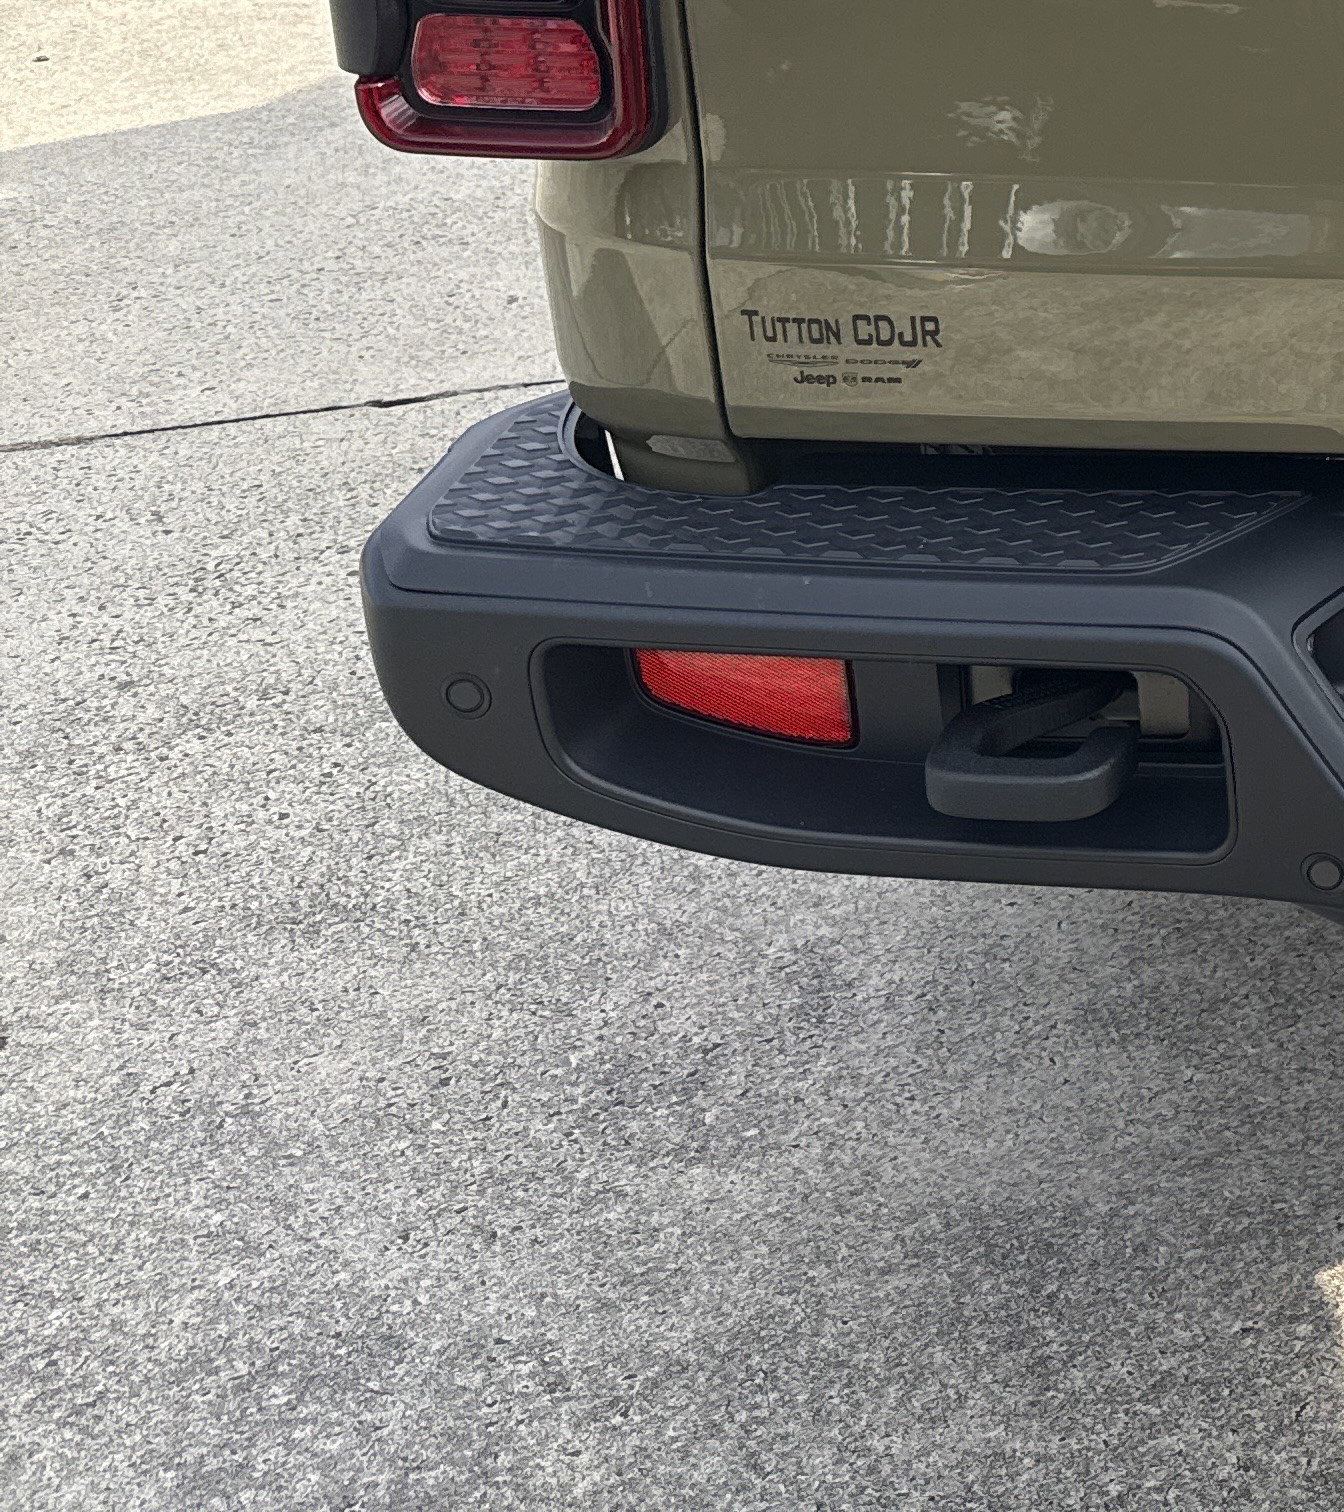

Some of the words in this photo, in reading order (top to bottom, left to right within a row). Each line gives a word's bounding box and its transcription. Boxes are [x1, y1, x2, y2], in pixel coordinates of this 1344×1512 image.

[740, 309, 842, 345] TUTTON
[852, 314, 943, 348] CDJR
[793, 370, 838, 387] Jeep
[861, 376, 903, 384] RAM
